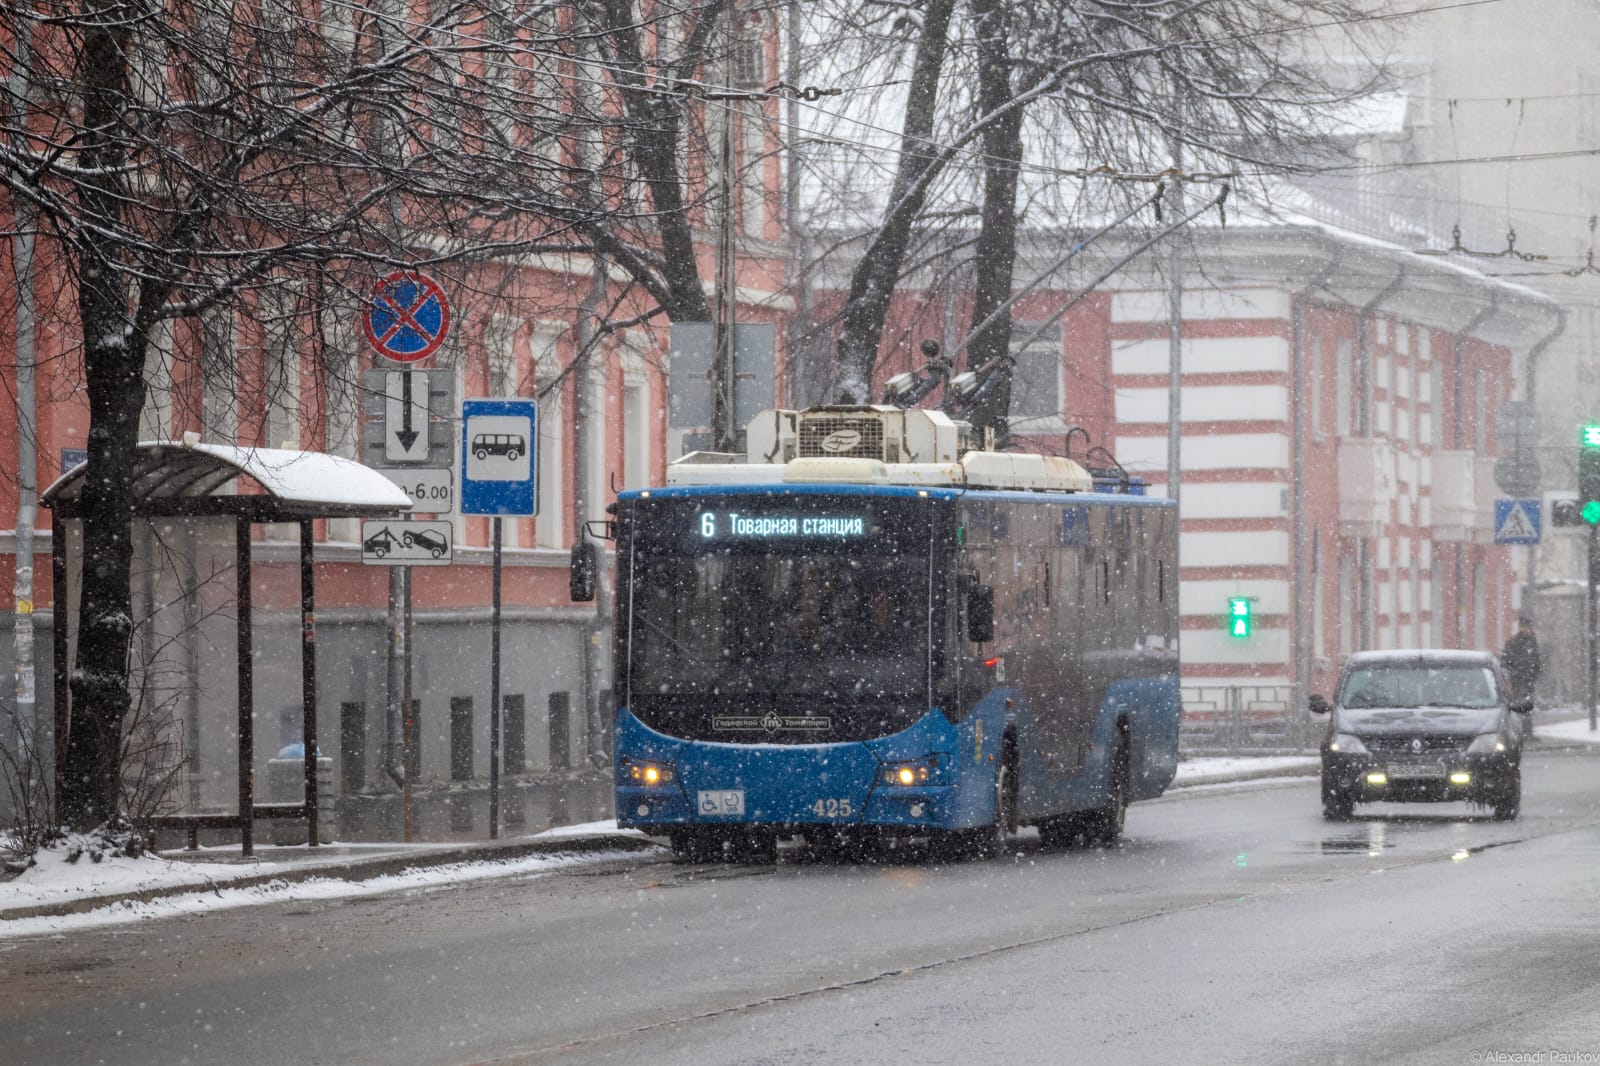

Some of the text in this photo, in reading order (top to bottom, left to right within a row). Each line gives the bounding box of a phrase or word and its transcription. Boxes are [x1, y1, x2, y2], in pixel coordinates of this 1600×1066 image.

[702, 512, 863, 537] 6 Товарная станция
[813, 799, 851, 818] 425
